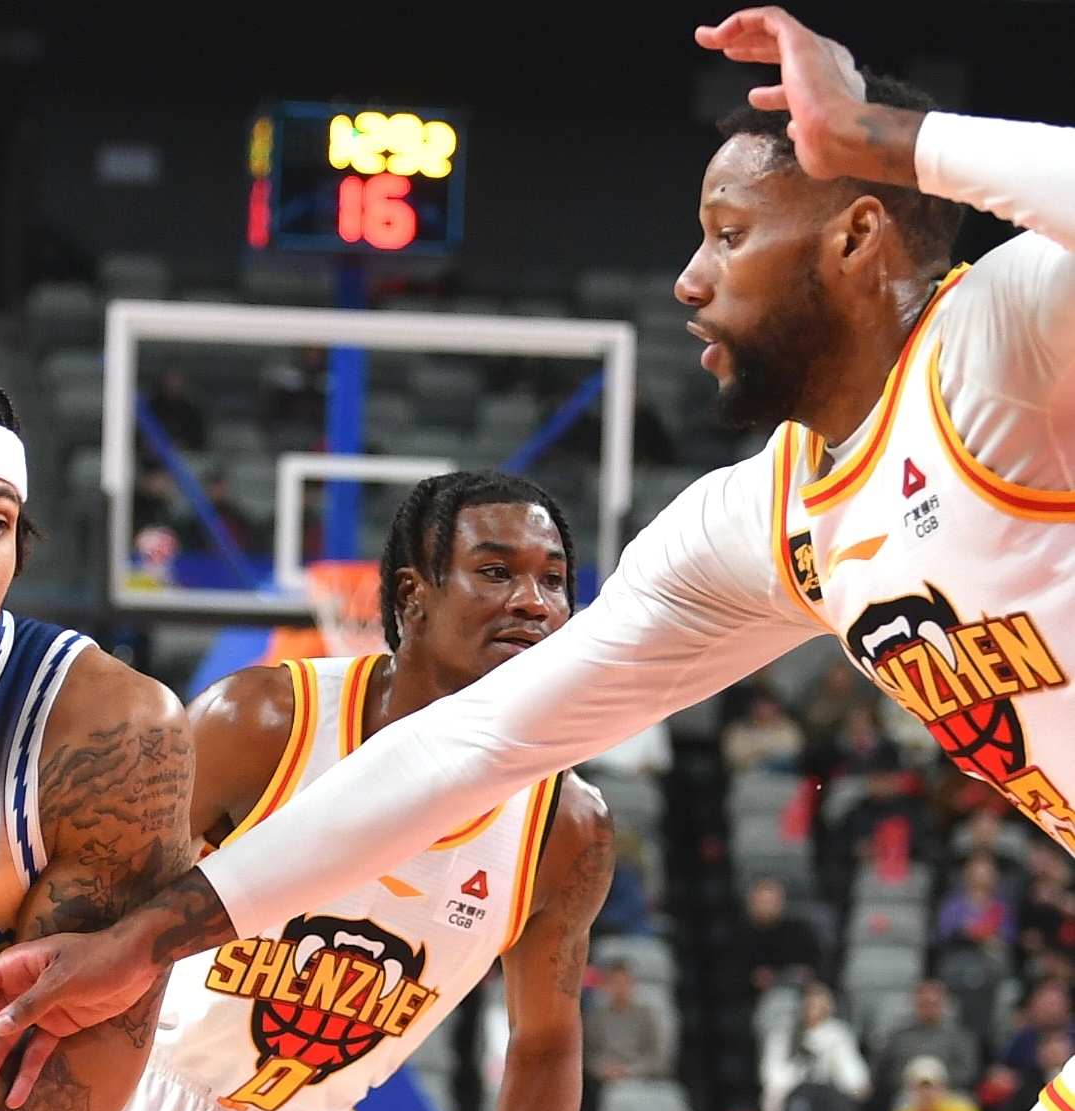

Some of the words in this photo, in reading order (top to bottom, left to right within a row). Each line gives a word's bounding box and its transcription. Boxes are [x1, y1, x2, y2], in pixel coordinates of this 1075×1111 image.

[338, 172, 417, 250] 16
[915, 515, 939, 538] CGB
[873, 610, 1070, 724] NZHEN
[448, 913, 473, 929] CGB
